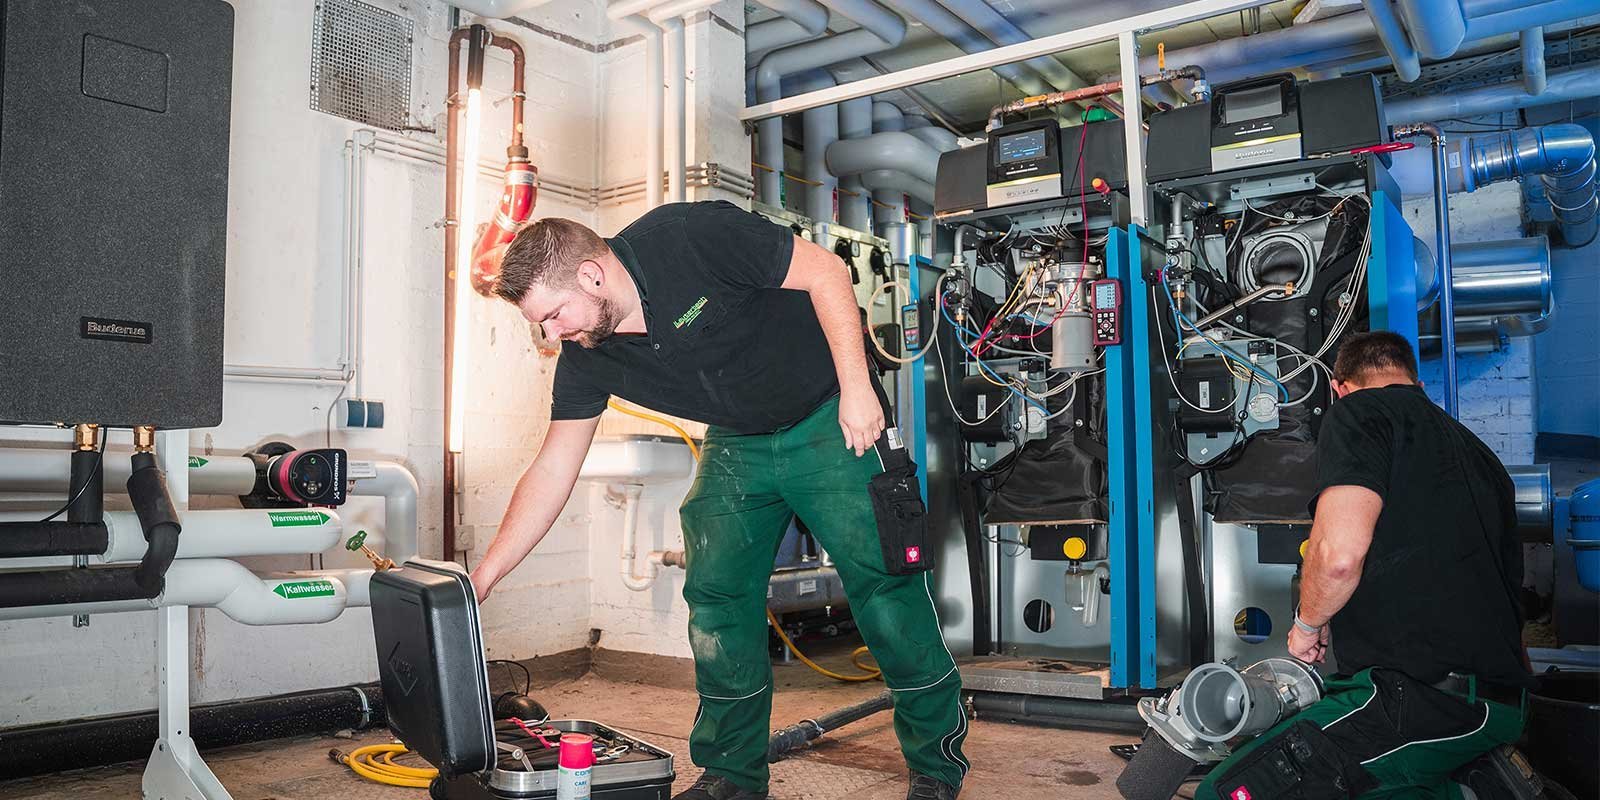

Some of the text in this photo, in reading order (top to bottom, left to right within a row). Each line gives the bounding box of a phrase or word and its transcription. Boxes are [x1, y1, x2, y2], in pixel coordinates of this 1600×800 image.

[87, 321, 146, 336] Buderus
[270, 514, 319, 522] Warmwasser
[286, 584, 335, 594] Kaltwasser
